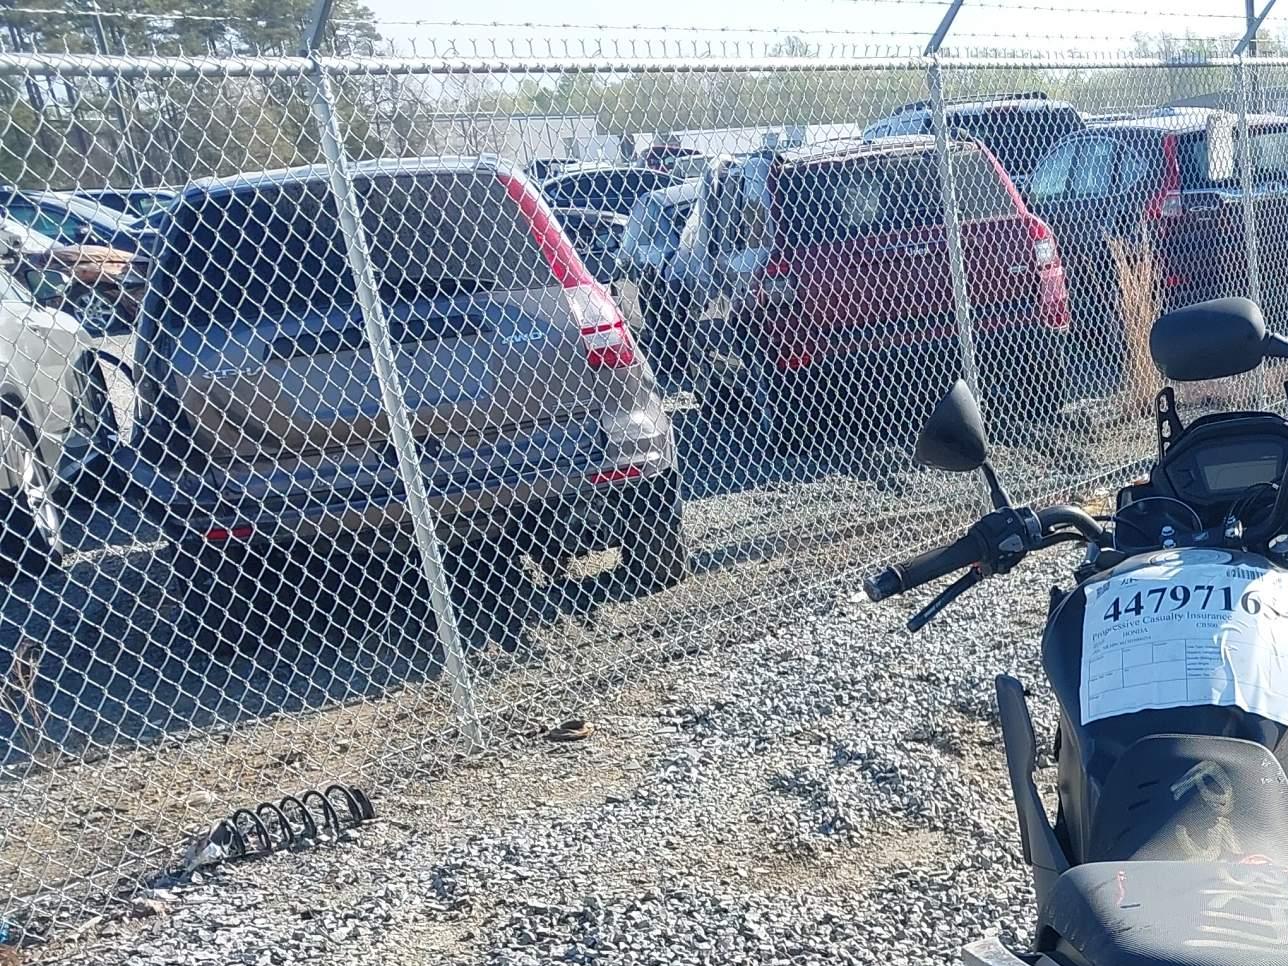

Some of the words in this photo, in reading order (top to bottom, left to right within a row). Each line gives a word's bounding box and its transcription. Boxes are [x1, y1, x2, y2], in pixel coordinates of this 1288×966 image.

[1092, 618, 1140, 642] Progressive
[1142, 611, 1185, 624] Casualty
[1186, 610, 1233, 622] Insurance
